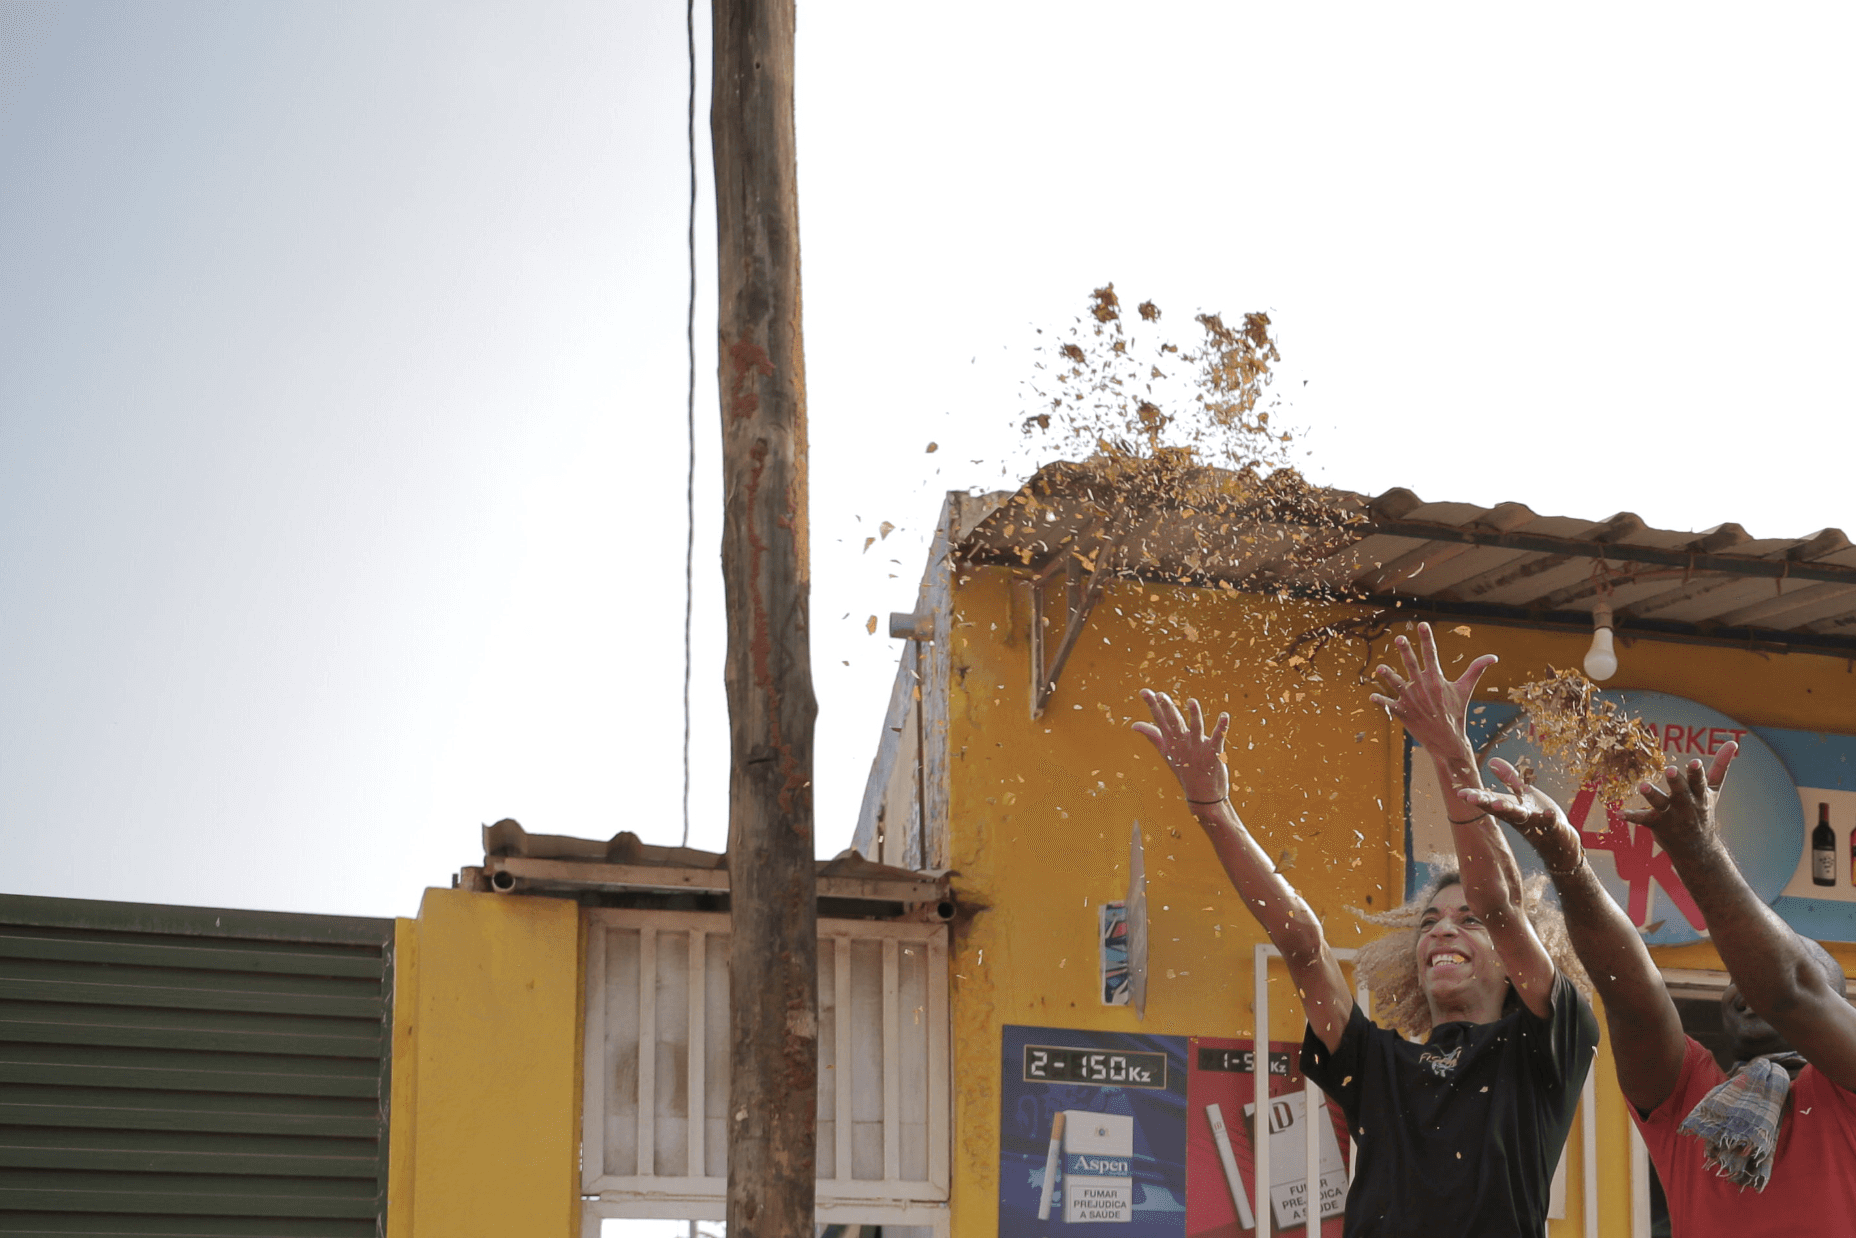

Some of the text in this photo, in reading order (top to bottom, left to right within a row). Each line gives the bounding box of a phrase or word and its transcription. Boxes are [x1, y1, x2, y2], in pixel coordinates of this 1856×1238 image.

[1648, 722, 1748, 758] ARKET
[1073, 1155, 1129, 1175] Aspen
[1083, 1189, 1118, 1199] FUMAR
[1289, 1178, 1329, 1197] FUR
[1073, 1199, 1127, 1210] PREJUDICA
[1079, 1210, 1087, 1219] A
